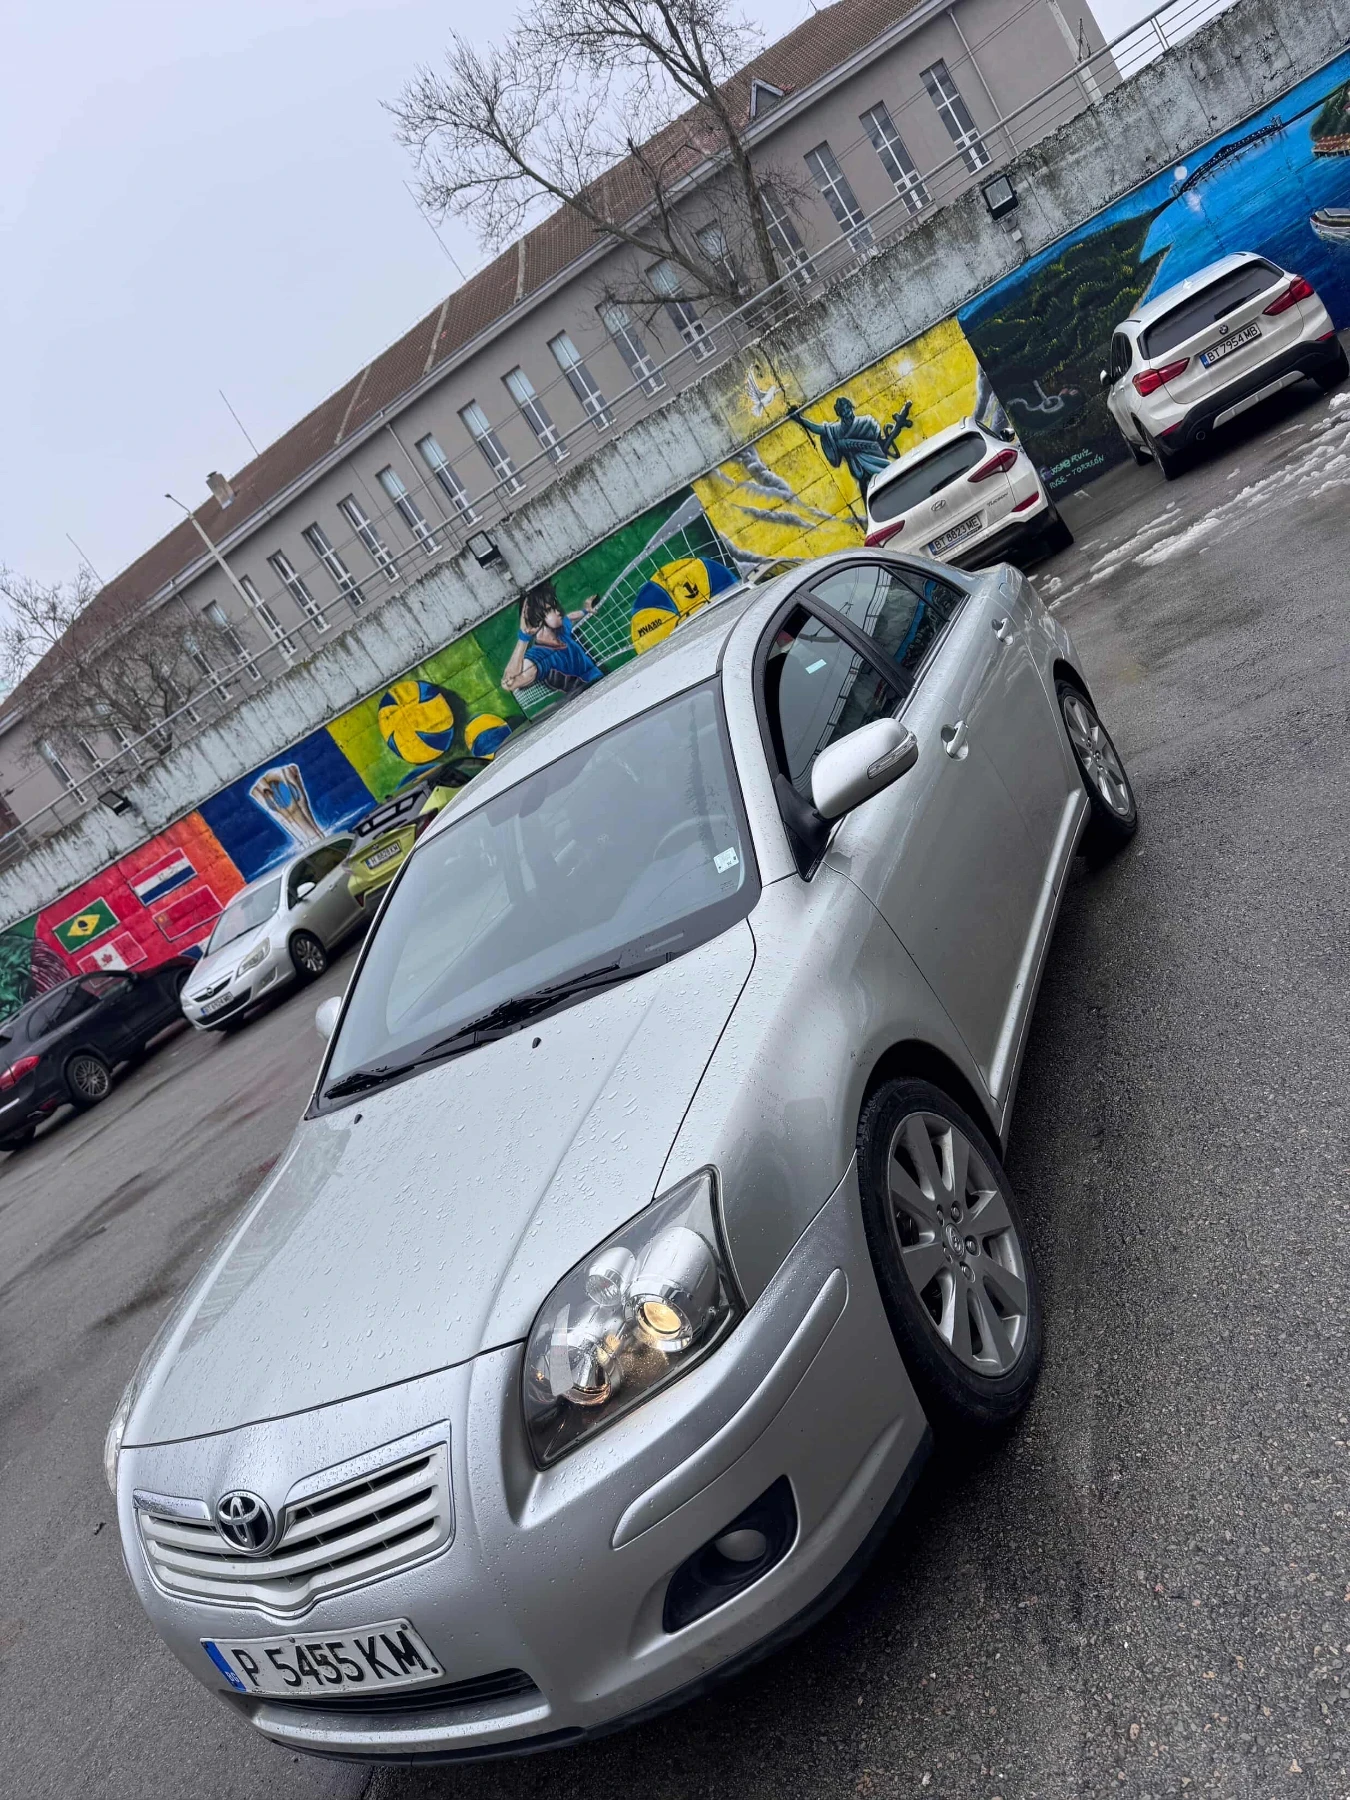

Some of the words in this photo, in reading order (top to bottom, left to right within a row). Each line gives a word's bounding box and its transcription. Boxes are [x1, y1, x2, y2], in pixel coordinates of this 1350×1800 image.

[1207, 347, 1220, 361] BT
[1220, 333, 1244, 353] 7954
[1243, 326, 1258, 340] MB
[934, 537, 946, 550] BT
[946, 526, 967, 542] 8823
[966, 517, 979, 530] ME
[231, 1648, 260, 1687] P
[264, 1641, 364, 1687] 5455
[353, 1630, 429, 1680] KM
